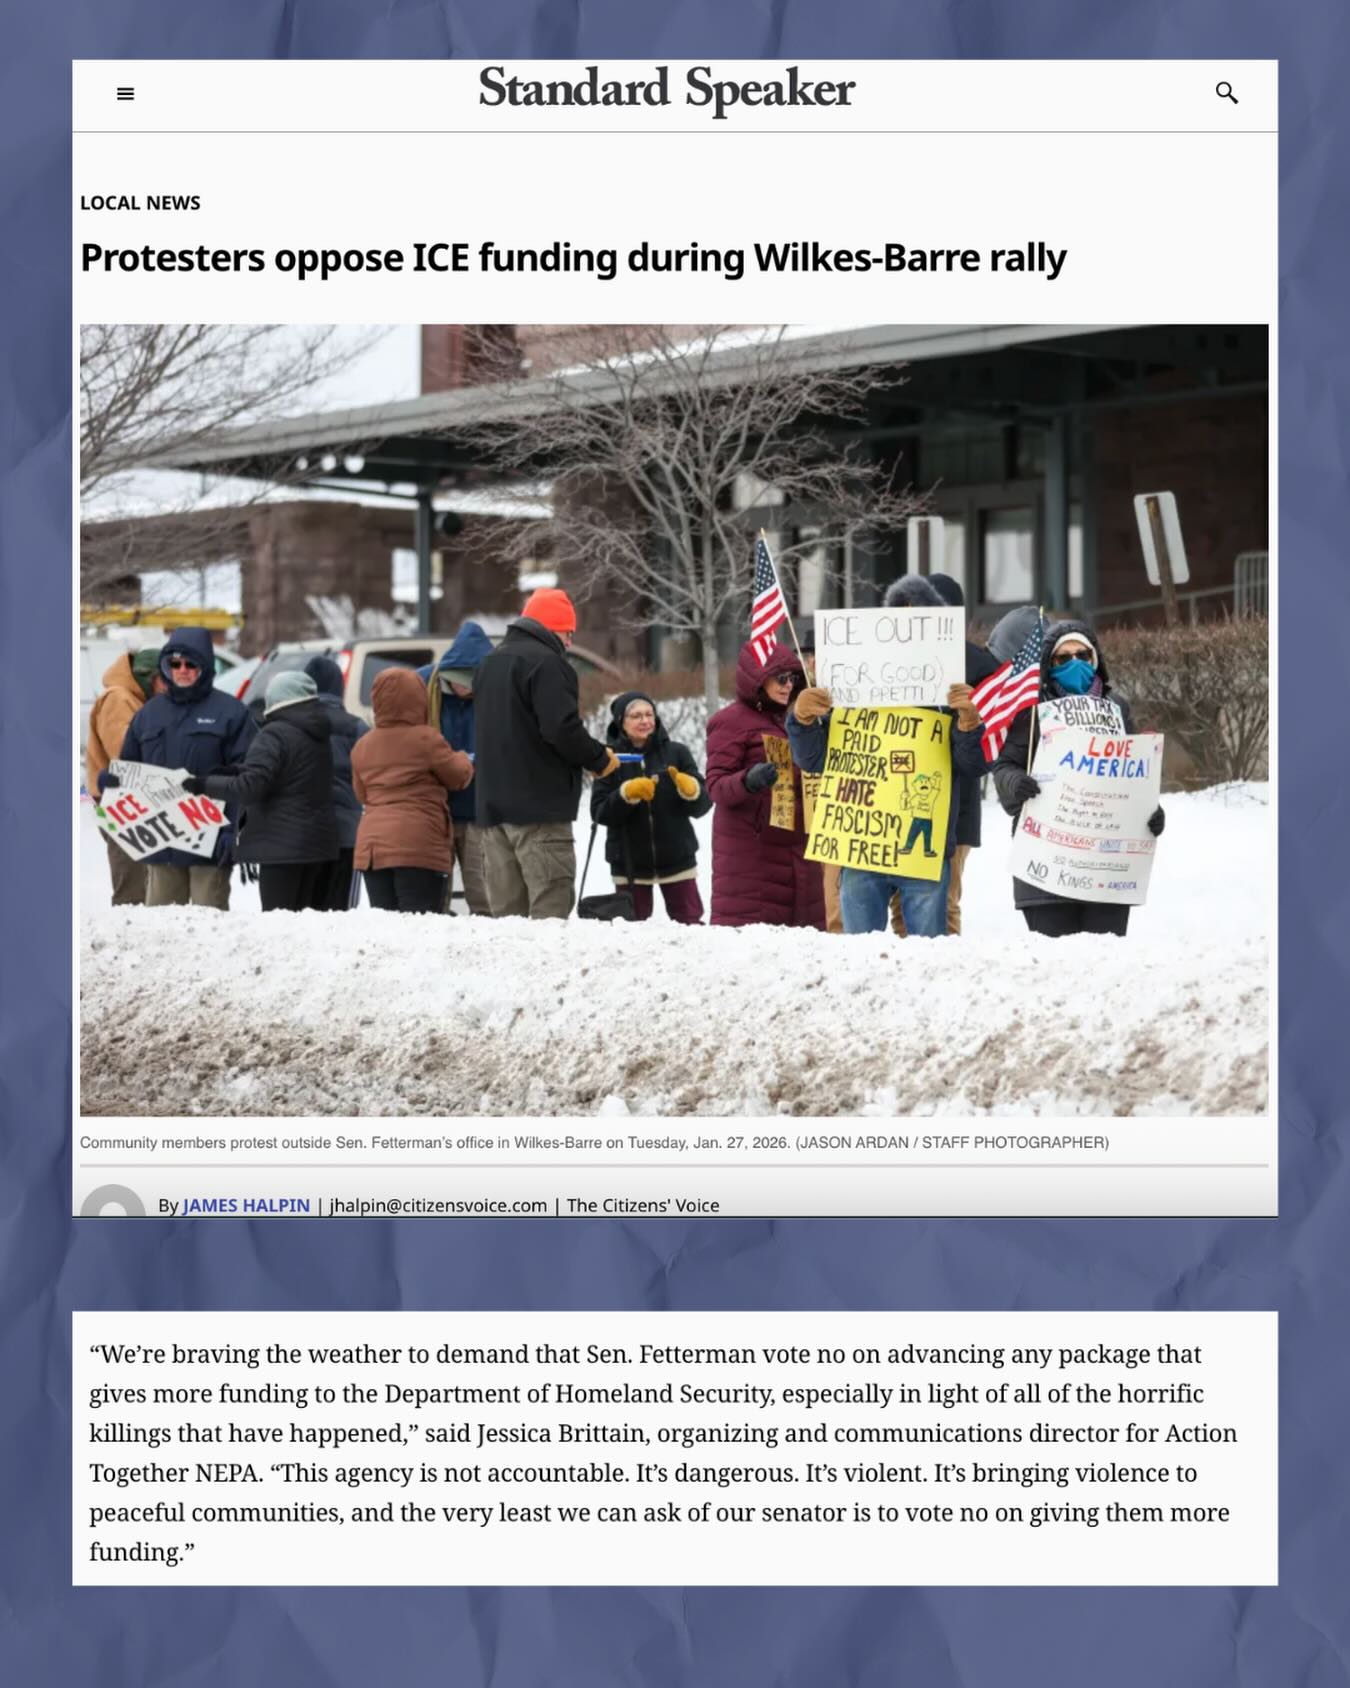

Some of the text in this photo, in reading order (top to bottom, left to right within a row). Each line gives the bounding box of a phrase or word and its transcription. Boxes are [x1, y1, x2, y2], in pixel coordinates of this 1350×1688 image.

[823, 616, 862, 646] ICE
[881, 656, 944, 688] GOOD)
[1052, 697, 1114, 716] YOUR TAX
[837, 707, 944, 744] I AM NOT A
[842, 728, 881, 753] PAID
[1087, 736, 1134, 758] LOVE
[1059, 750, 1149, 778] AMERICA!
[820, 775, 877, 807] I HATE
[106, 793, 149, 826] ICE
[177, 793, 223, 831] NO
[821, 804, 902, 839] FASCISM
[118, 811, 186, 854] VOTE
[812, 833, 899, 868] FOR FREE!
[1027, 859, 1049, 879] NO
[1057, 869, 1095, 889] KINGS
